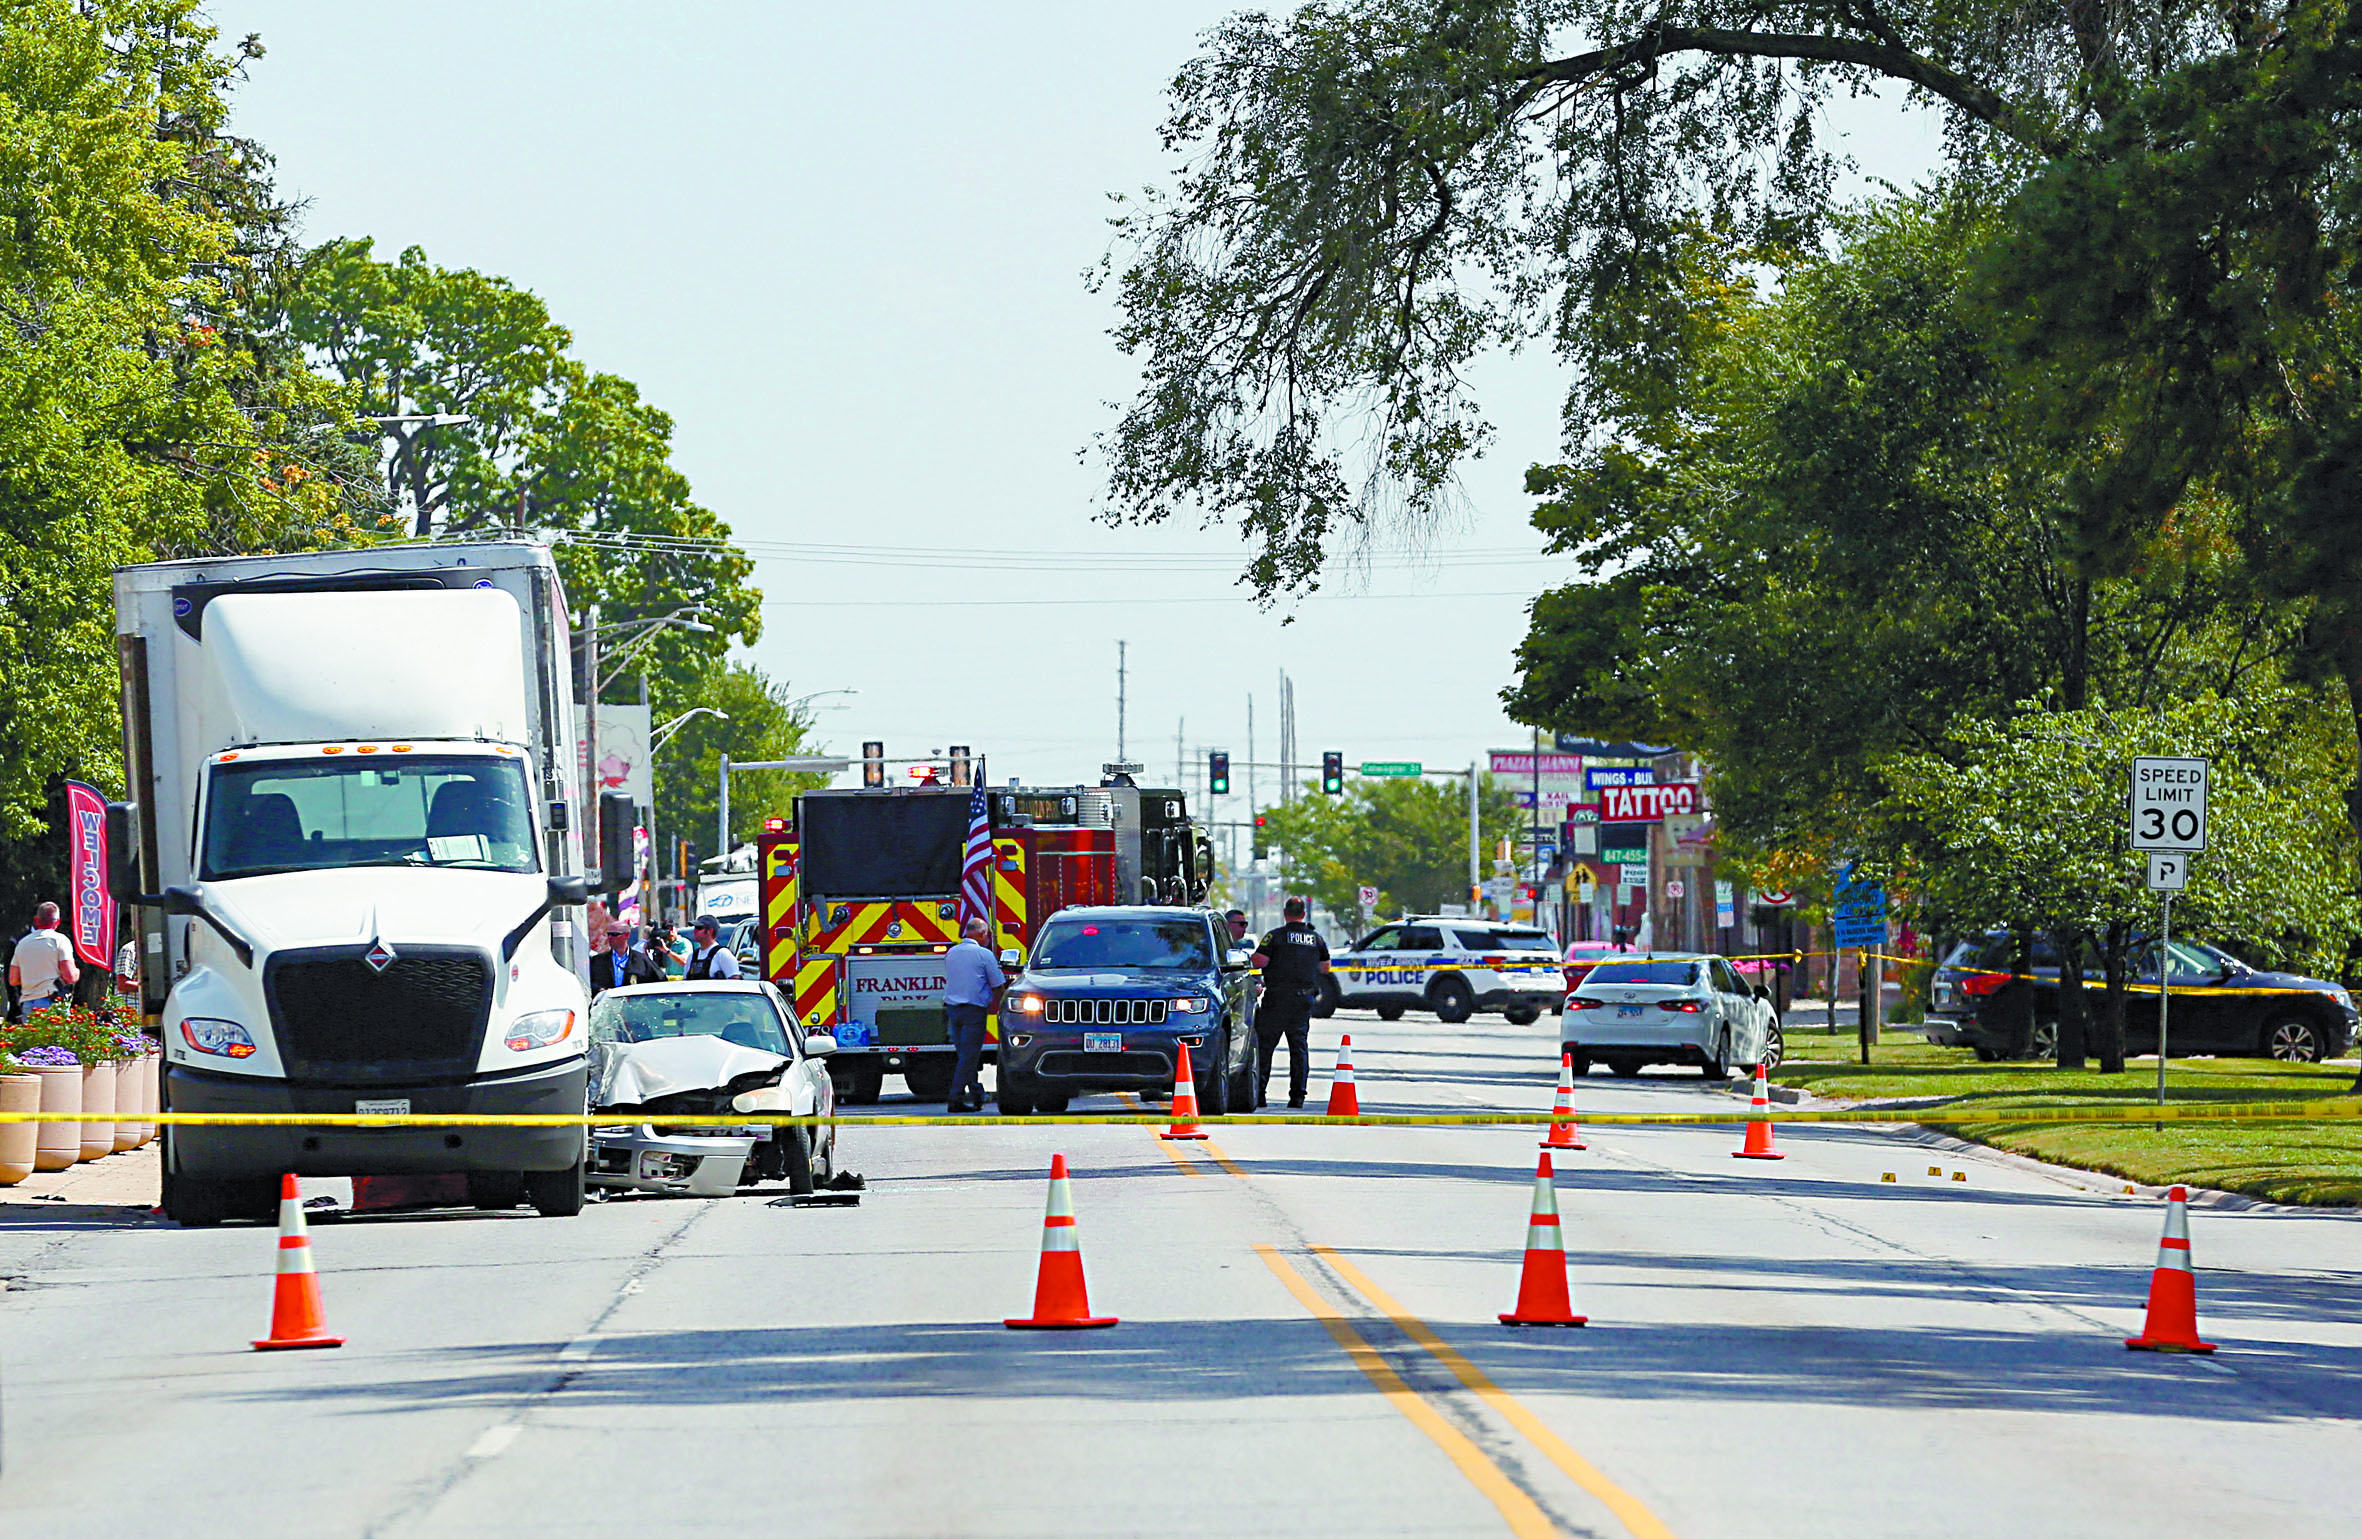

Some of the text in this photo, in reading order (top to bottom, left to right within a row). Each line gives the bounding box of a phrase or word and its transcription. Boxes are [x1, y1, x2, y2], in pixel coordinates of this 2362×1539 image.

[1591, 772, 1626, 785] WINGS
[2140, 768, 2201, 783] SPEED
[1603, 786, 1693, 818] TATTOO
[2145, 787, 2194, 802] LIMIT
[2139, 808, 2199, 841] 30
[2160, 861, 2176, 881] P
[1290, 932, 1315, 945] POLICE
[856, 976, 947, 993] FRANKLIN
[1366, 970, 1425, 985] POLICE
